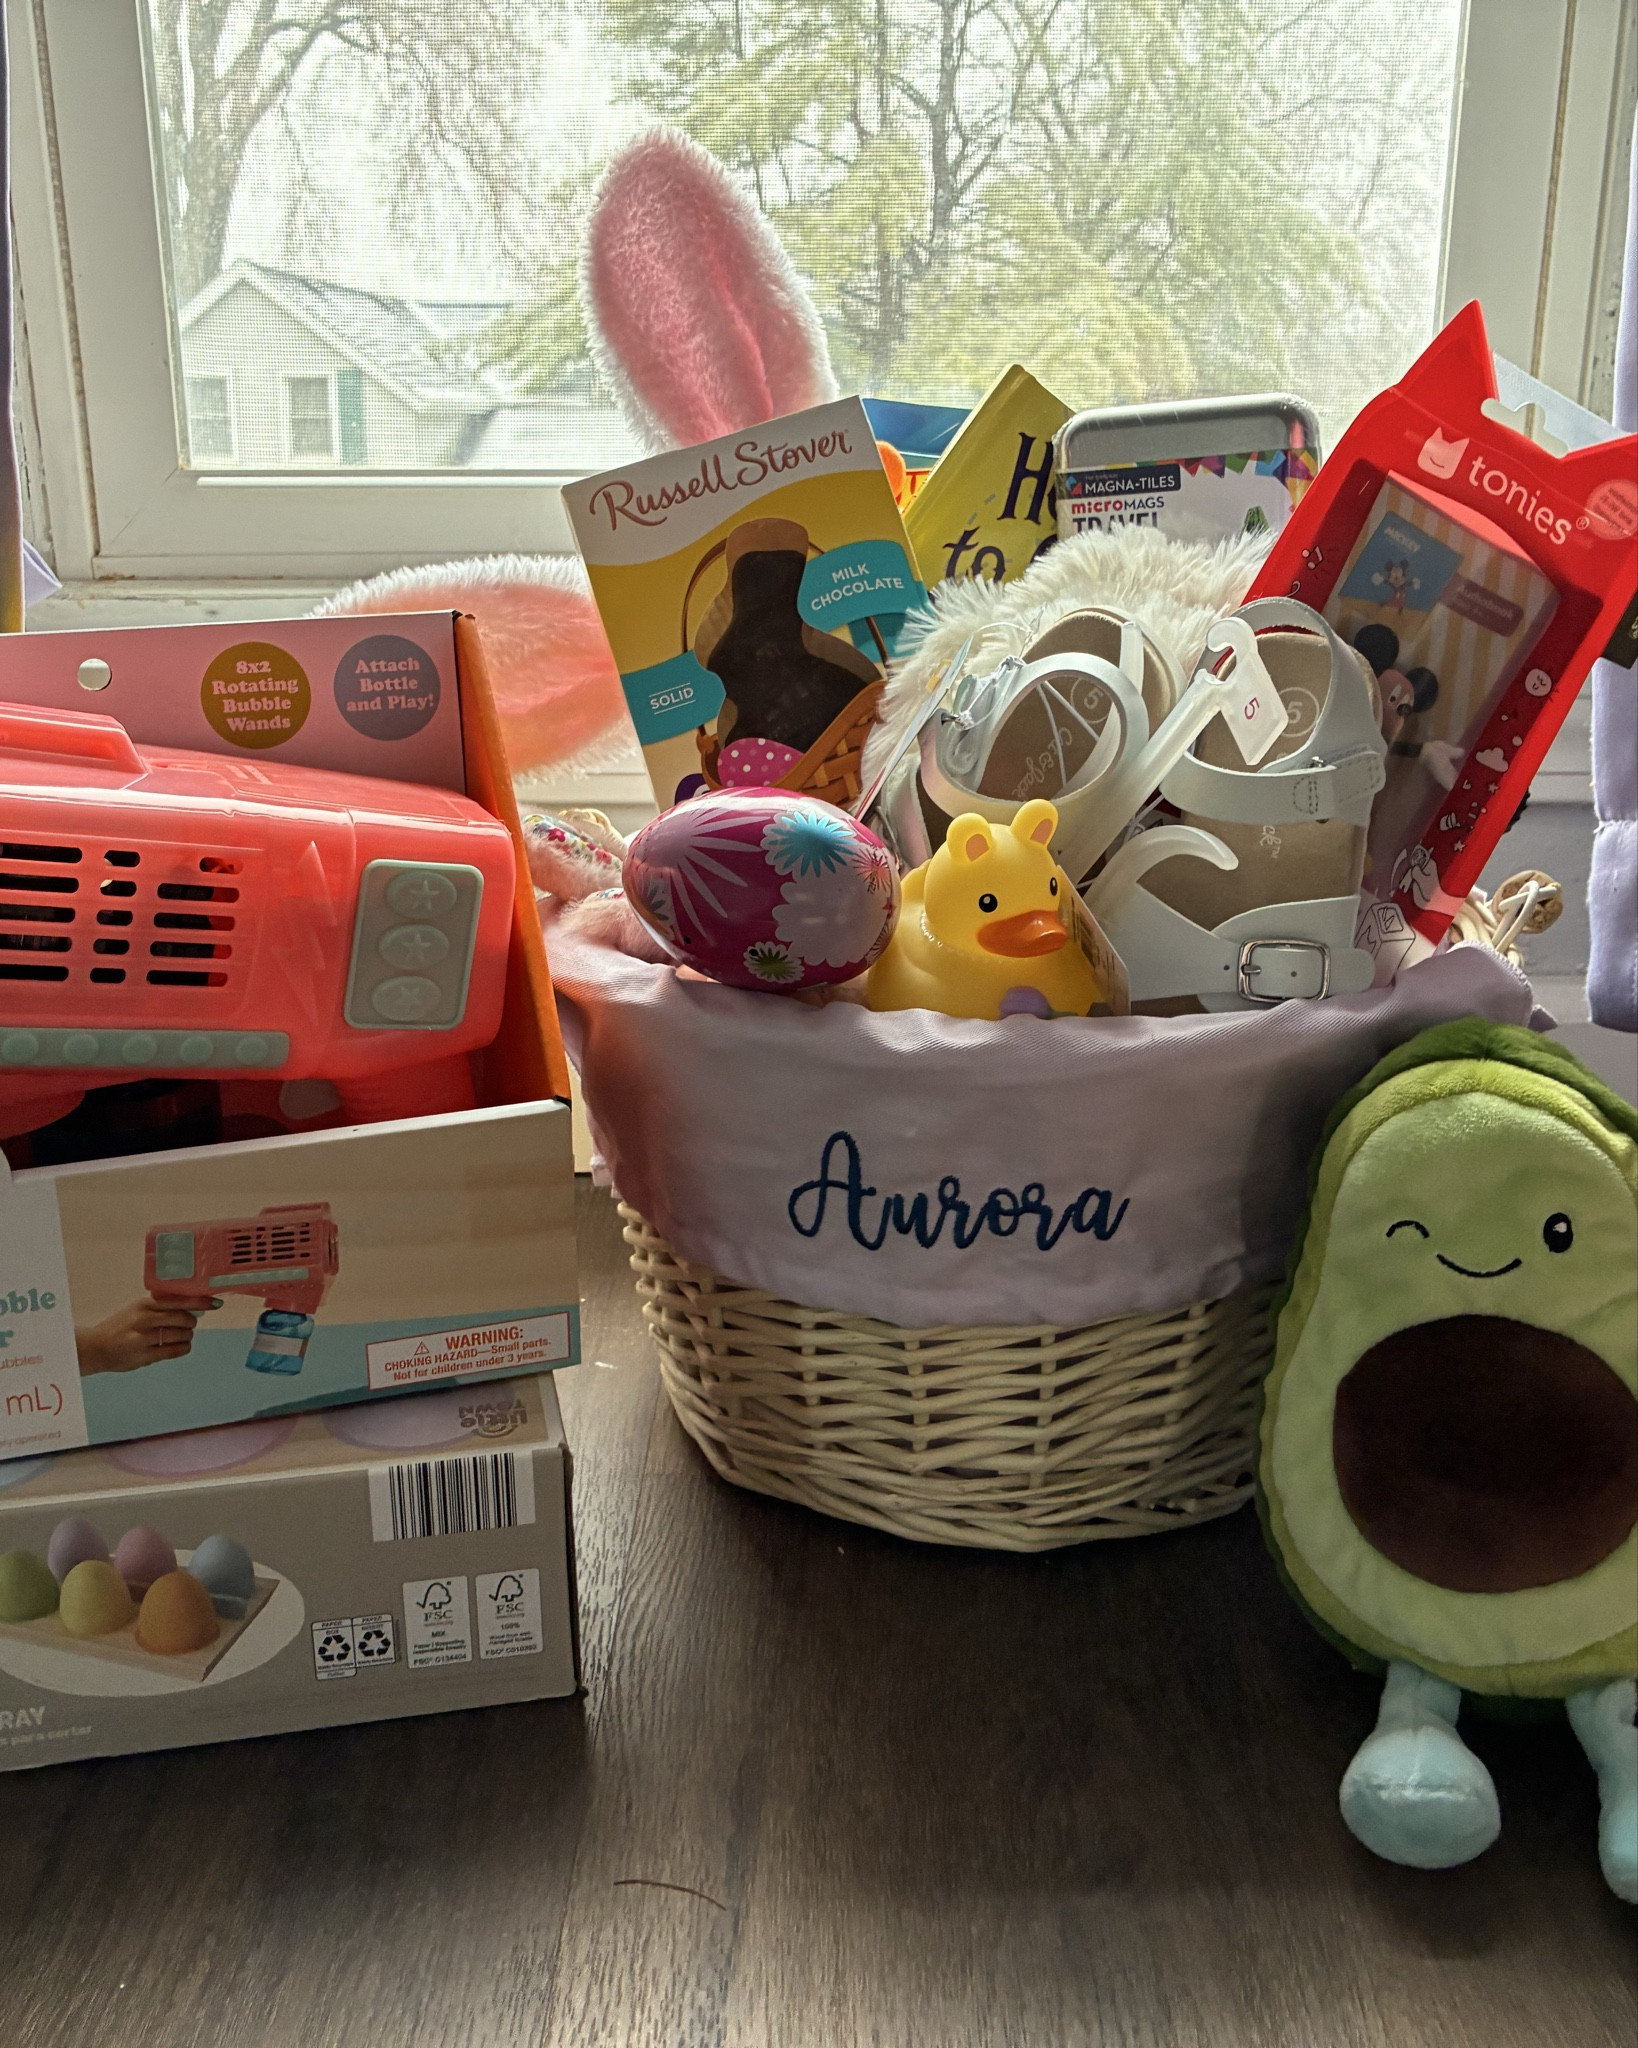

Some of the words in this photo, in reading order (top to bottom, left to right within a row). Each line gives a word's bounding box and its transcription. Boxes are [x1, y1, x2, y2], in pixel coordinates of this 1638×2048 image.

[589, 454, 738, 531] Russell
[734, 430, 852, 486] Stover
[1085, 475, 1175, 494] MAGNA-TILES
[831, 563, 870, 583] MILK
[810, 577, 904, 611] CHOCOLATE
[236, 660, 272, 674] 8x2
[355, 657, 420, 674] Attach
[211, 678, 299, 695] Rotating
[359, 676, 418, 692] Bottle
[223, 697, 292, 713] Bubble
[346, 695, 382, 712] and
[387, 693, 434, 711] Play!
[650, 687, 694, 709] SOLID
[1084, 687, 1104, 709] 5
[1244, 697, 1260, 720] 5
[227, 715, 291, 732] Wands
[1288, 702, 1303, 724] 5
[788, 1130, 1130, 1251] Aurora
[445, 1326, 523, 1350] WARNING:
[385, 1357, 432, 1372] CHOKING
[522, 1337, 551, 1351] parts.
[394, 1371, 411, 1381] Not
[414, 1368, 428, 1378] for
[431, 1362, 473, 1375] children
[476, 1356, 504, 1368] under
[508, 1354, 514, 1363] 3
[516, 1350, 547, 1364] years.
[6, 1383, 63, 1416] mL)
[424, 1610, 452, 1621] FSC
[496, 1602, 524, 1614] FSC
